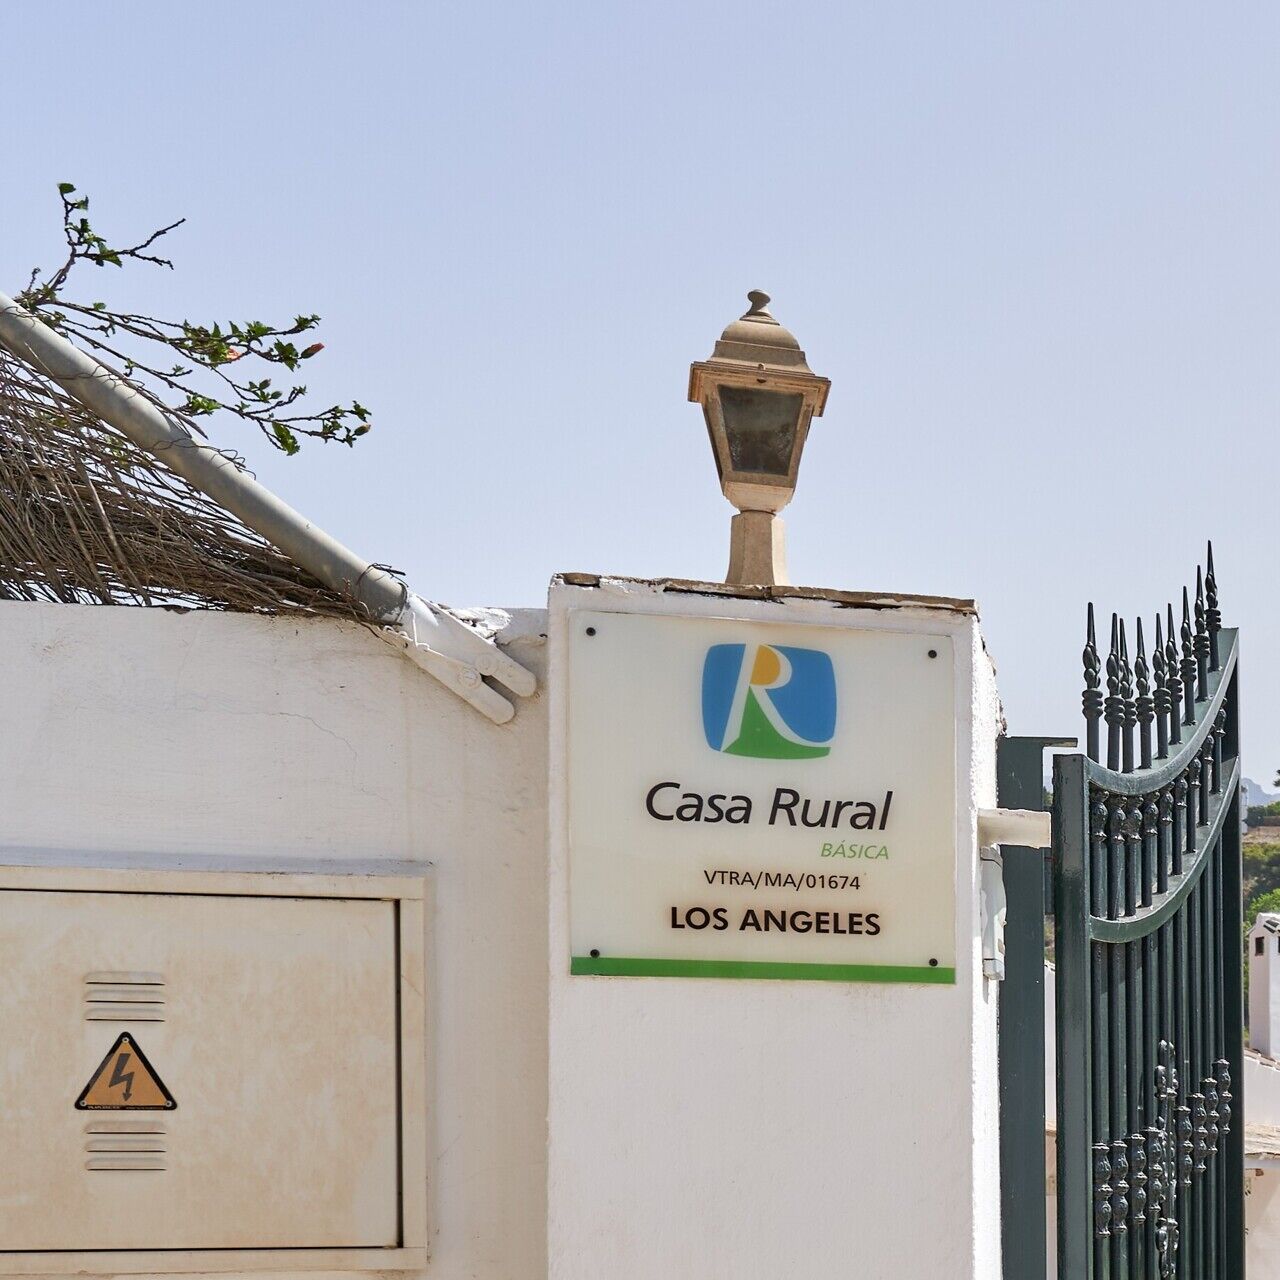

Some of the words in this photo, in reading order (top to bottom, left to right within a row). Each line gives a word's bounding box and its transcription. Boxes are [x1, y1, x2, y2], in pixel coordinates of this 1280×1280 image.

[645, 781, 752, 825] Casa
[768, 787, 894, 831] Rural
[820, 840, 889, 860] BÁSICA
[703, 869, 861, 892] VTRA/MA/01674
[671, 906, 729, 931] LOS
[738, 908, 881, 937] ANGELES
